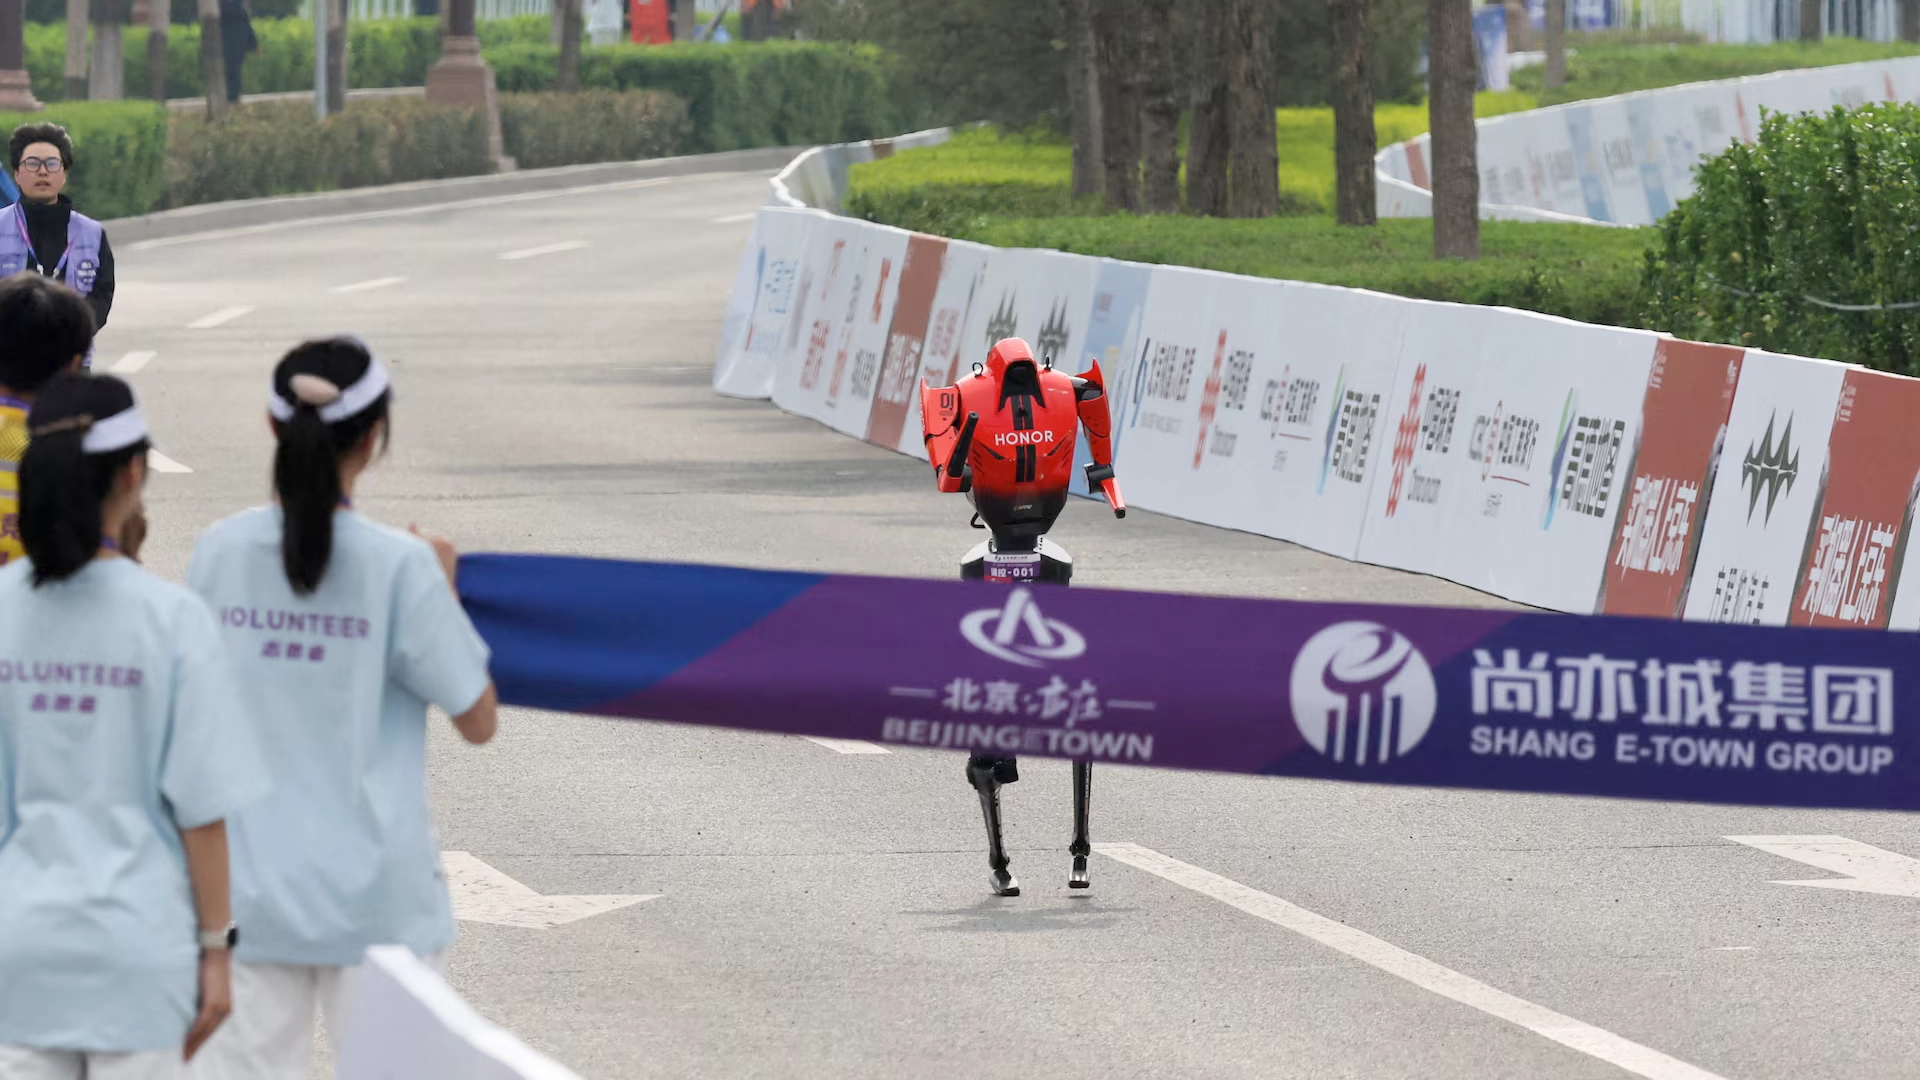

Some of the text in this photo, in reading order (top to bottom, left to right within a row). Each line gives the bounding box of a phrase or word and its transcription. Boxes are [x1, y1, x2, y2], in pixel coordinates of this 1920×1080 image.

[994, 430, 1054, 446] HONOR
[1802, 513, 1897, 625] 买机器人上京东
[1471, 649, 1894, 735] 尚亦城集团
[1470, 727, 1895, 775] SHANG E-TOWN GROUP
